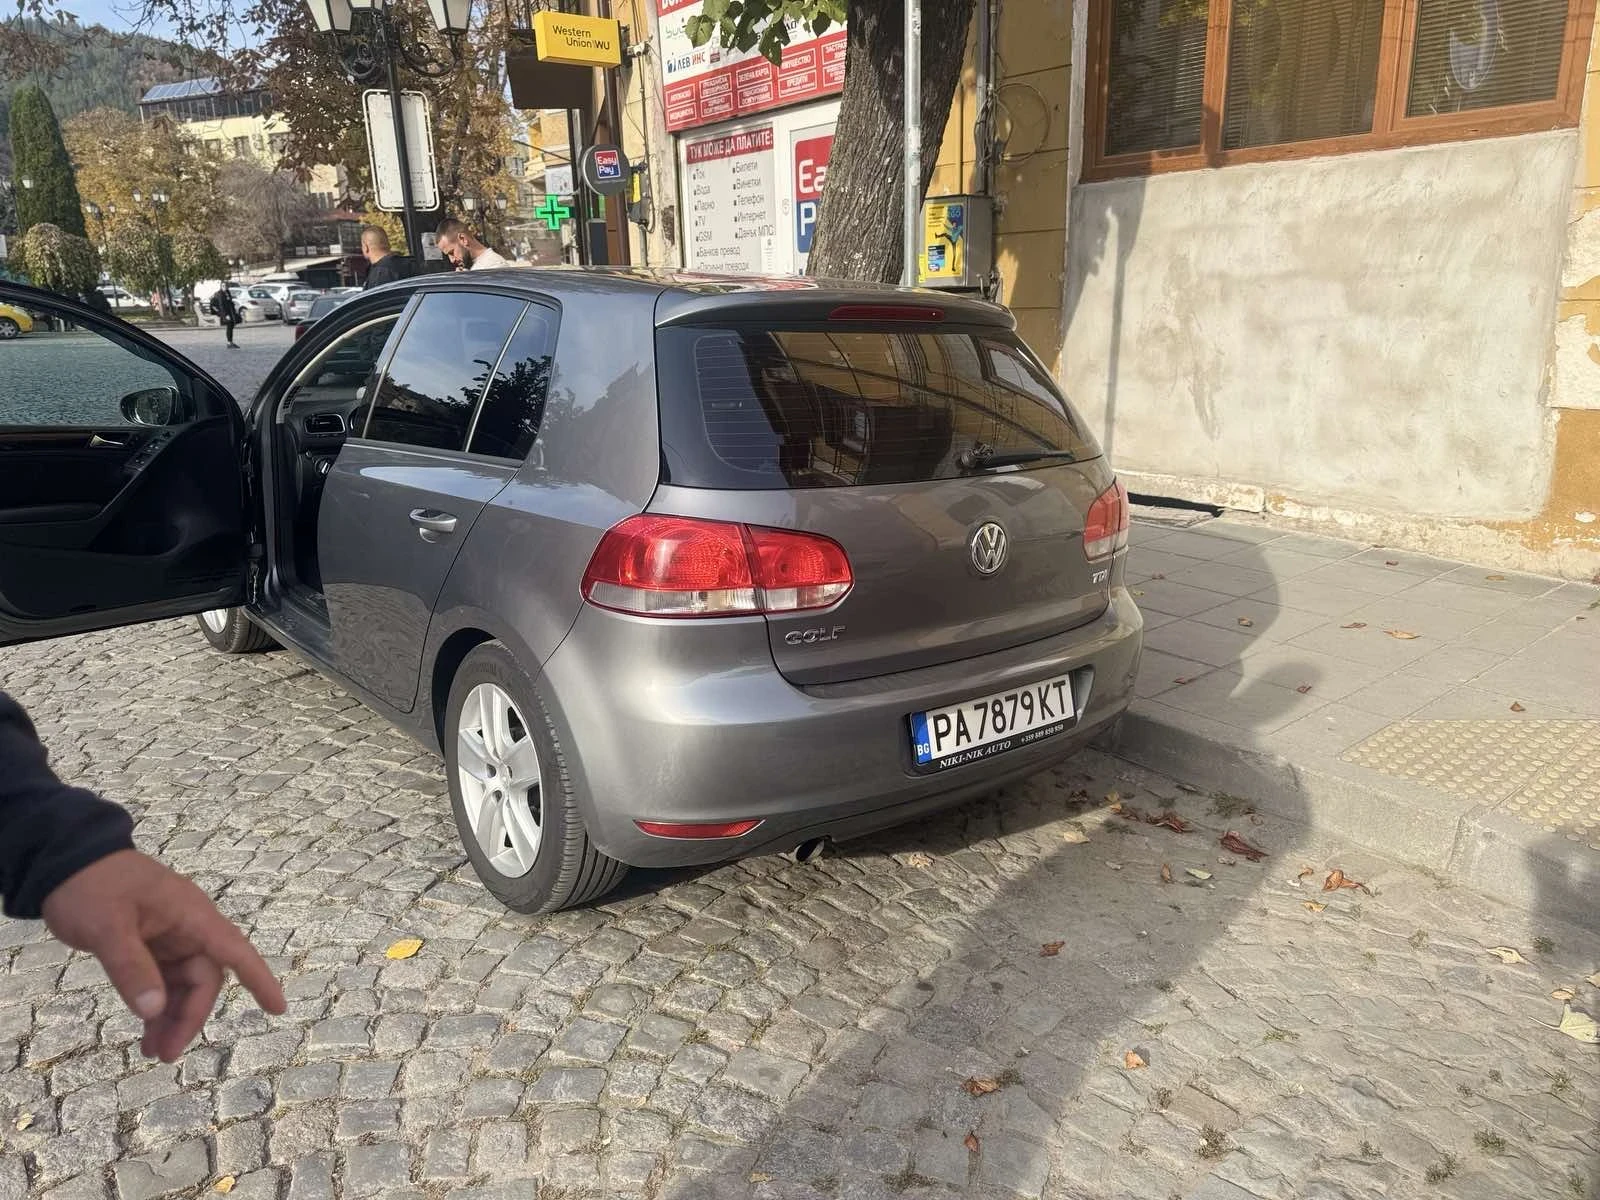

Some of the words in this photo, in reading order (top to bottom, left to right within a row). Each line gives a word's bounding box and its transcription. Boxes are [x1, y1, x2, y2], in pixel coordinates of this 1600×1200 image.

[552, 25, 591, 38] Western
[678, 56, 690, 70] ЛЕВ
[690, 144, 702, 159] ТУК
[703, 141, 723, 157] МОЖЕ
[725, 138, 735, 155] ДА
[597, 156, 617, 166] Easy
[599, 165, 614, 176] Pay
[696, 168, 705, 179] Ток
[798, 158, 828, 194] Ea
[696, 185, 711, 196] Вода
[737, 194, 765, 207] Телефон
[737, 210, 766, 222] Интернет
[785, 625, 846, 645] GOLF
[932, 680, 1066, 752] PA7879KT
[917, 743, 930, 756] BG
[939, 748, 984, 769] NIKI-NIK
[985, 740, 1012, 758] AUTO
